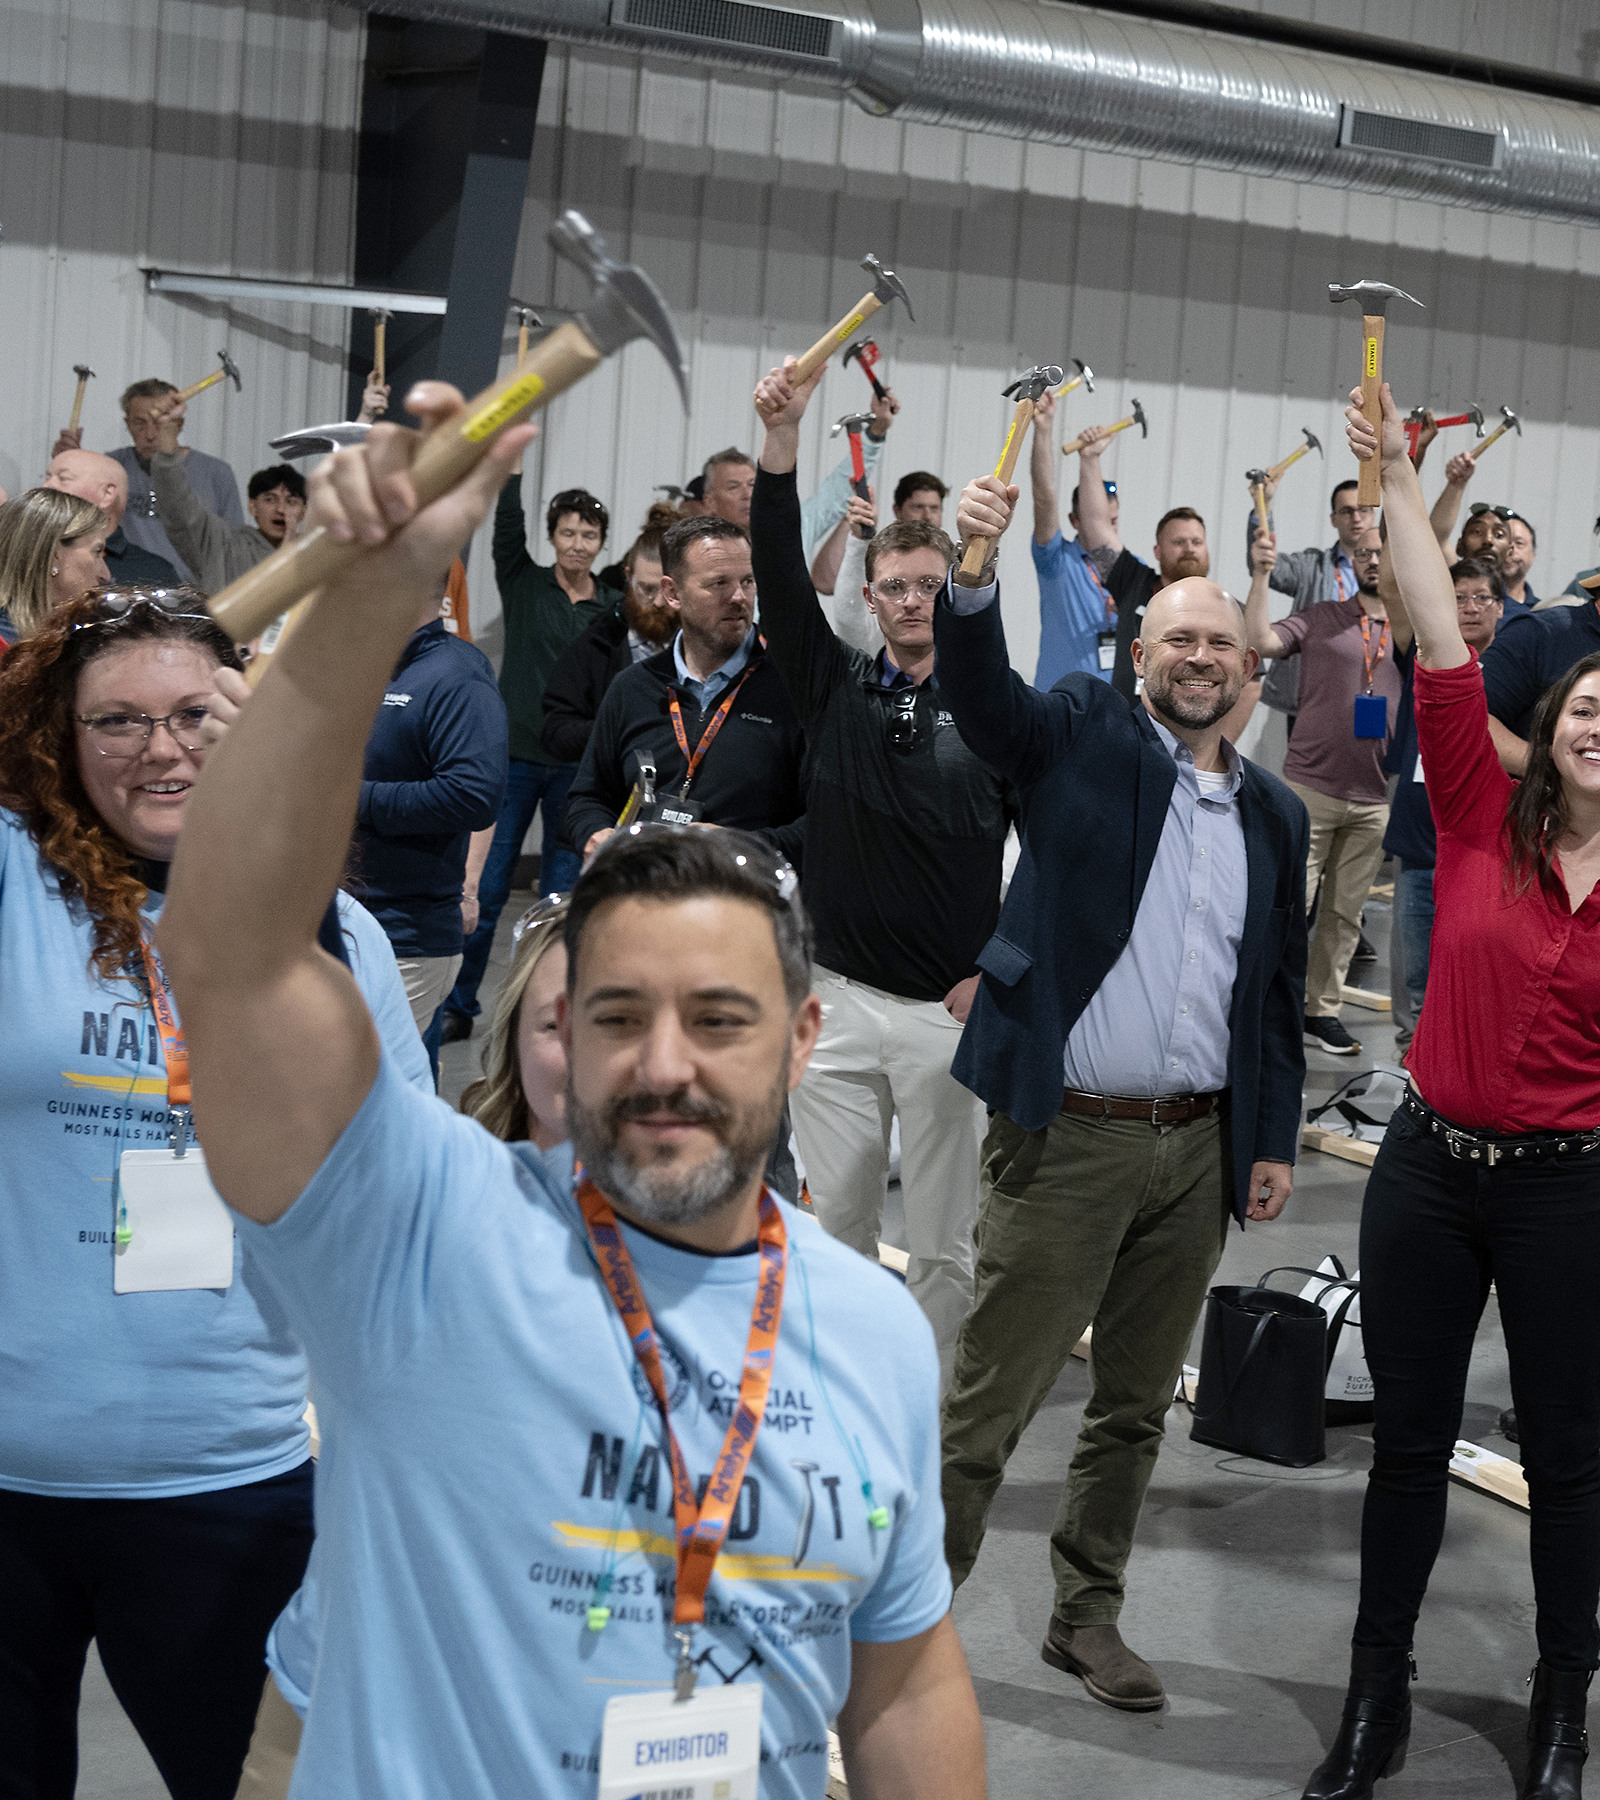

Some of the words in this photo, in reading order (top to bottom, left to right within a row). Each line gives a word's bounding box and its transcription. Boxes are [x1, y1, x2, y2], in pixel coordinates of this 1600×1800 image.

[660, 808, 694, 826] BUILDER
[47, 1100, 133, 1120] GUINNESS
[64, 1123, 98, 1137] MOST
[104, 1126, 140, 1139] NALS
[635, 1732, 728, 1767] EXHIBITOR
